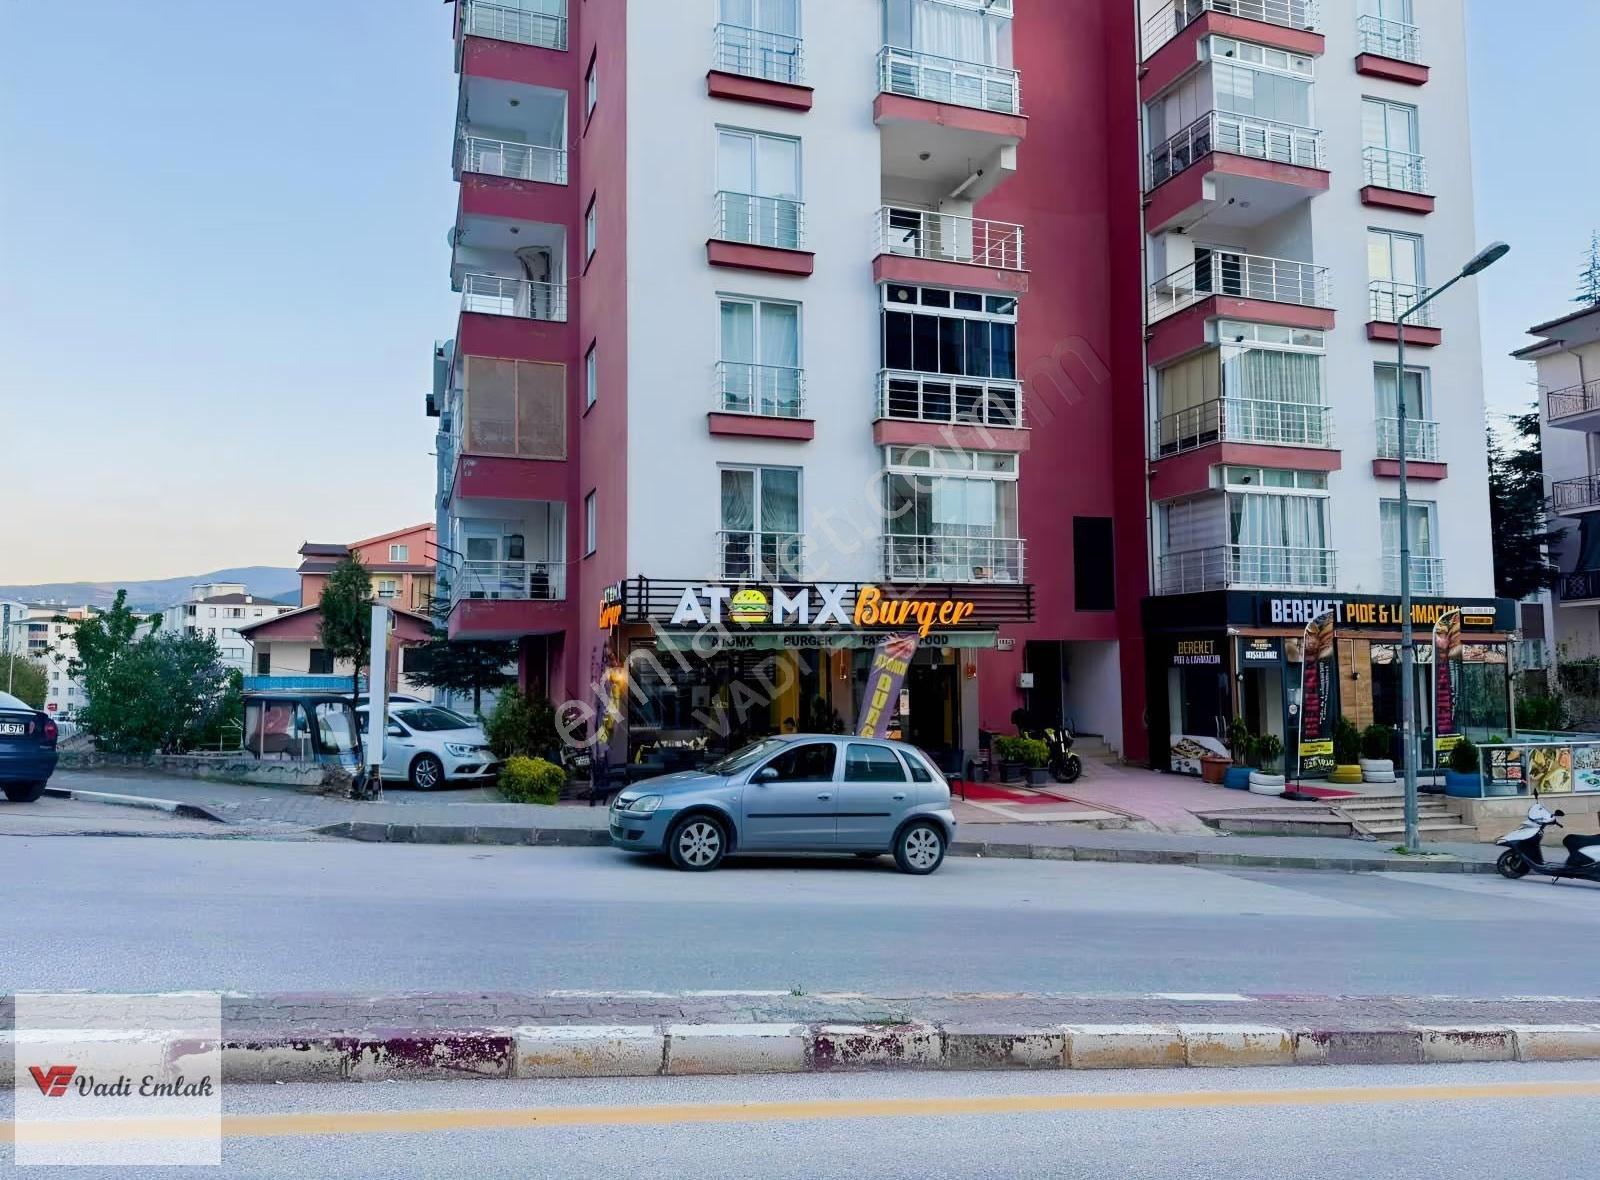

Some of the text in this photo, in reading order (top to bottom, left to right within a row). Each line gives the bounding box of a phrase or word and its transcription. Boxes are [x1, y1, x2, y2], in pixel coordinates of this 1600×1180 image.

[853, 585, 974, 638] Burger
[1271, 599, 1343, 622] BEREKET
[1346, 603, 1376, 623] PIDE
[1379, 605, 1388, 623] &
[783, 635, 833, 647] BURGER
